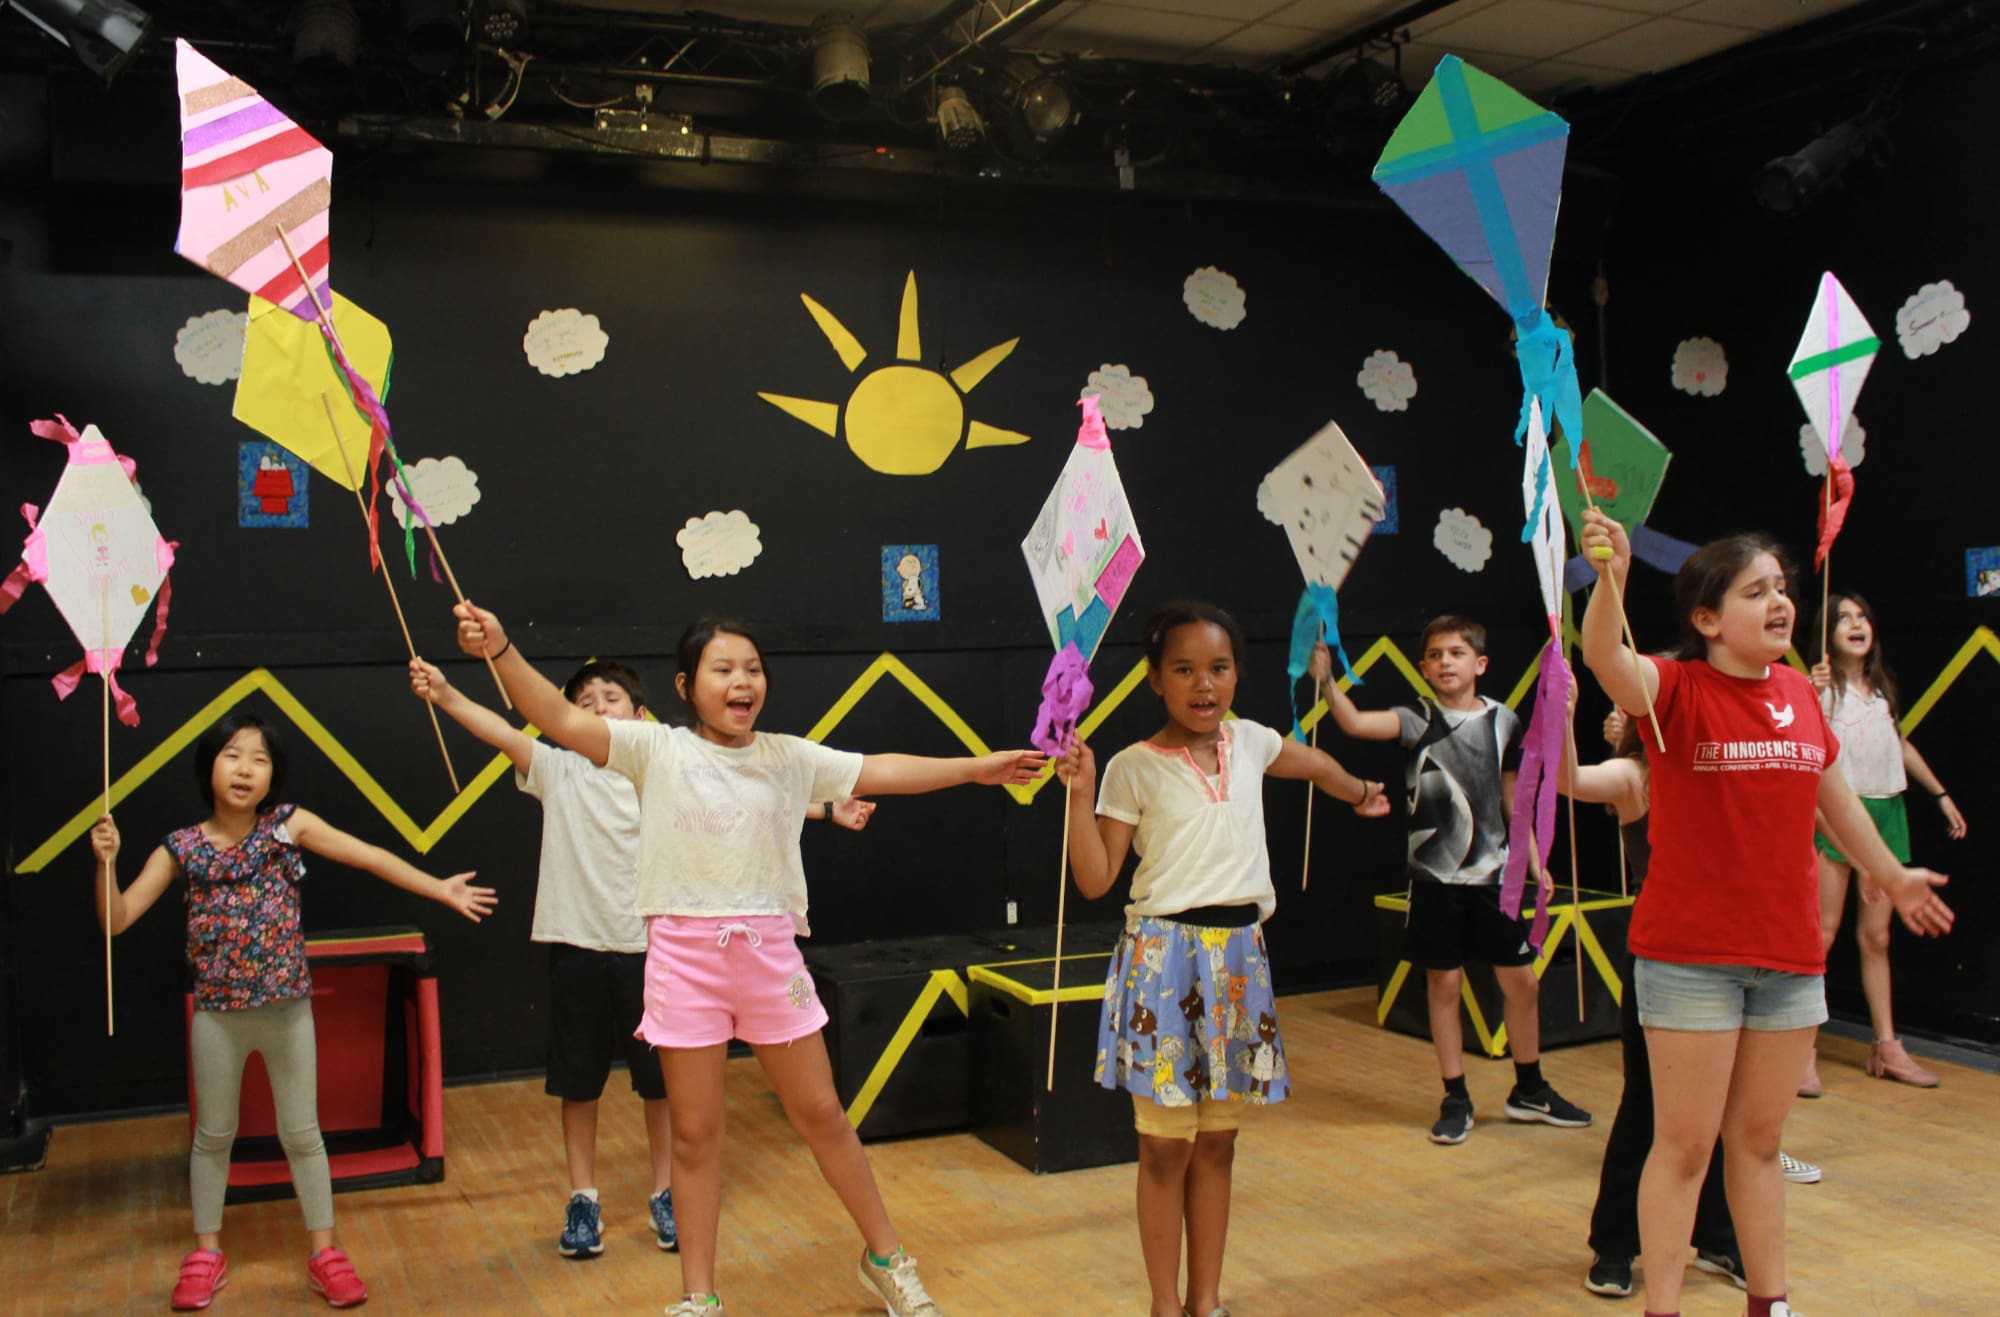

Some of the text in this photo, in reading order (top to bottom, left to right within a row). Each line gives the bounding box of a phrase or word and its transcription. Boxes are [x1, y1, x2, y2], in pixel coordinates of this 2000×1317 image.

[222, 169, 271, 213] AVA
[1701, 746, 1720, 760] THE
[1723, 741, 1799, 759] INNOCENCE
